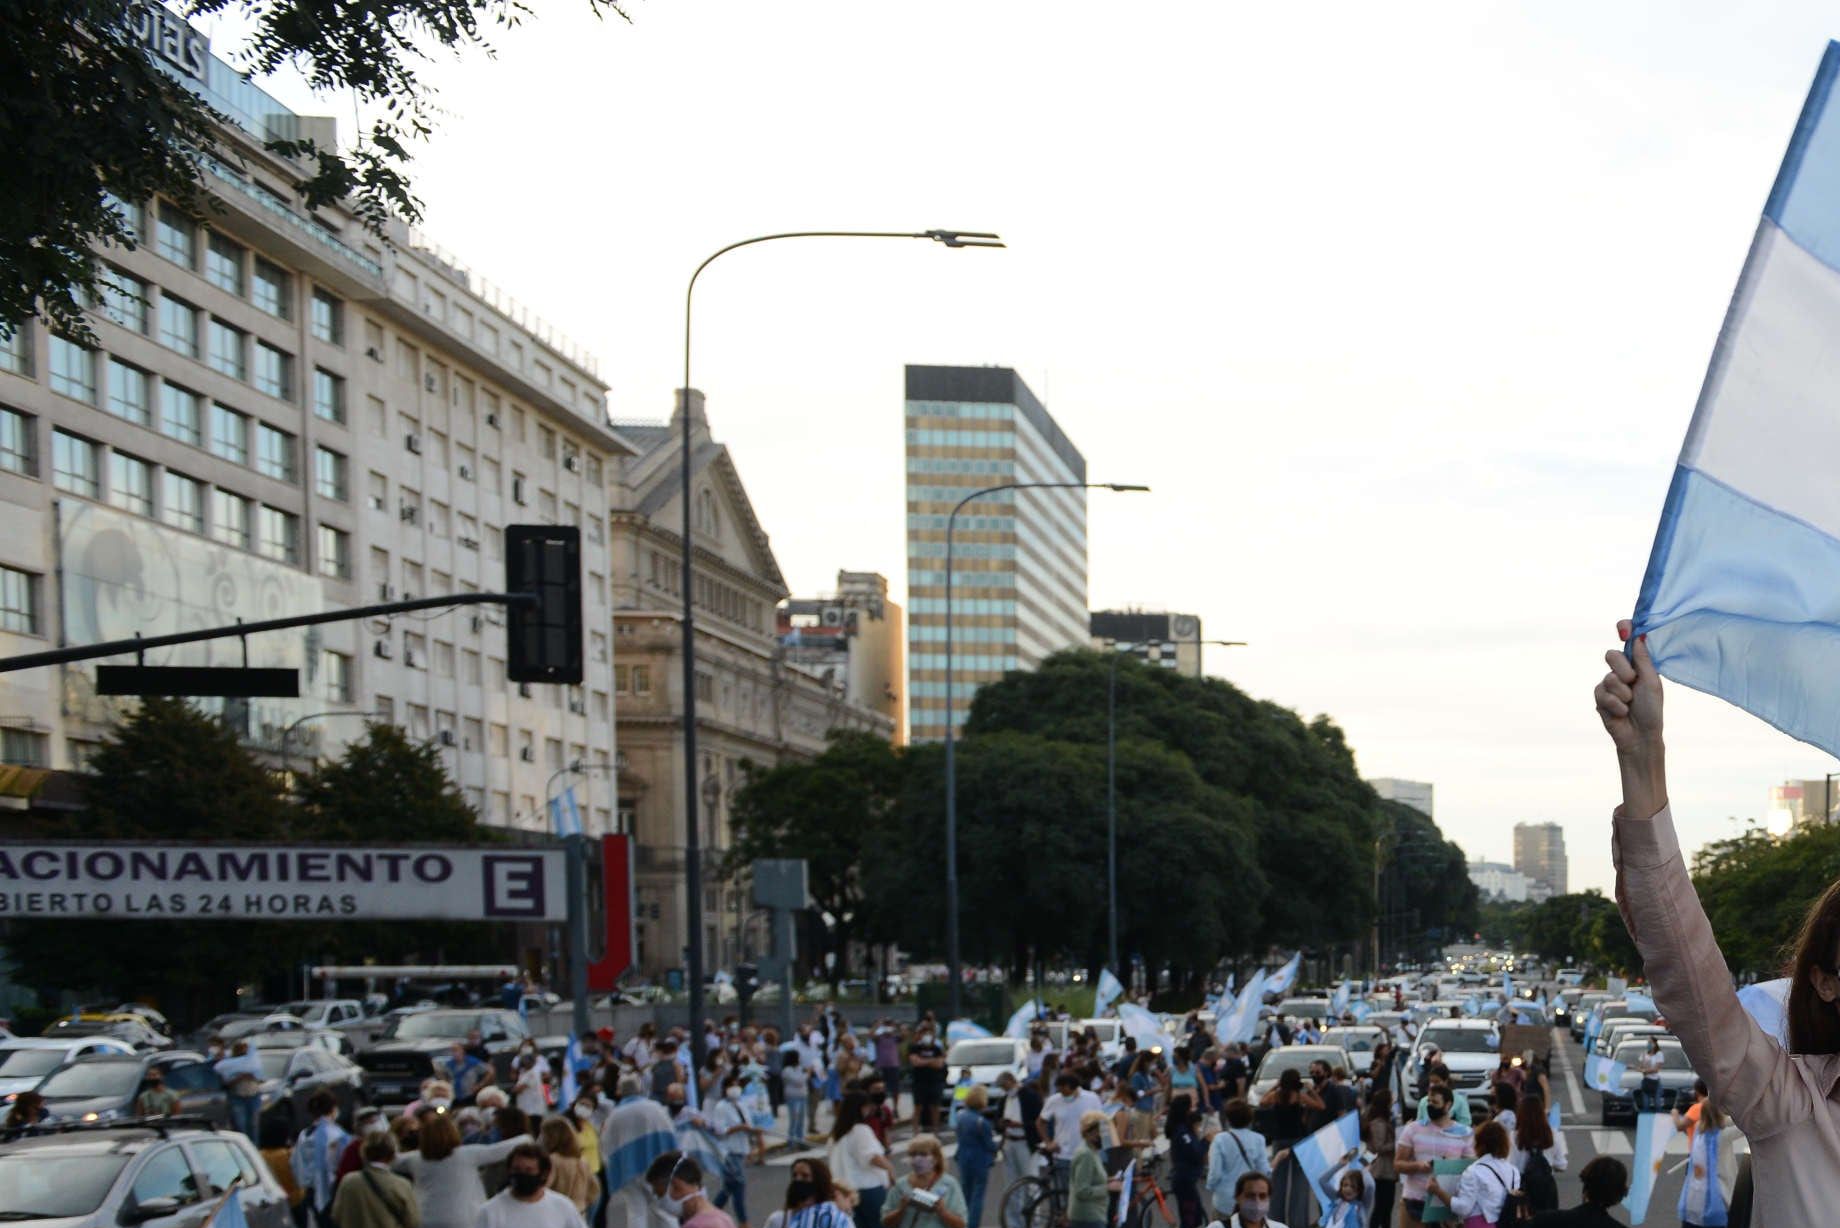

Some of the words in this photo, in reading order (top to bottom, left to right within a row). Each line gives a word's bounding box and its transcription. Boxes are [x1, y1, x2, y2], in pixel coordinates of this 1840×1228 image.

[125, 894, 187, 912] LAS
[199, 894, 231, 913] 24
[244, 894, 357, 913] HORAS
